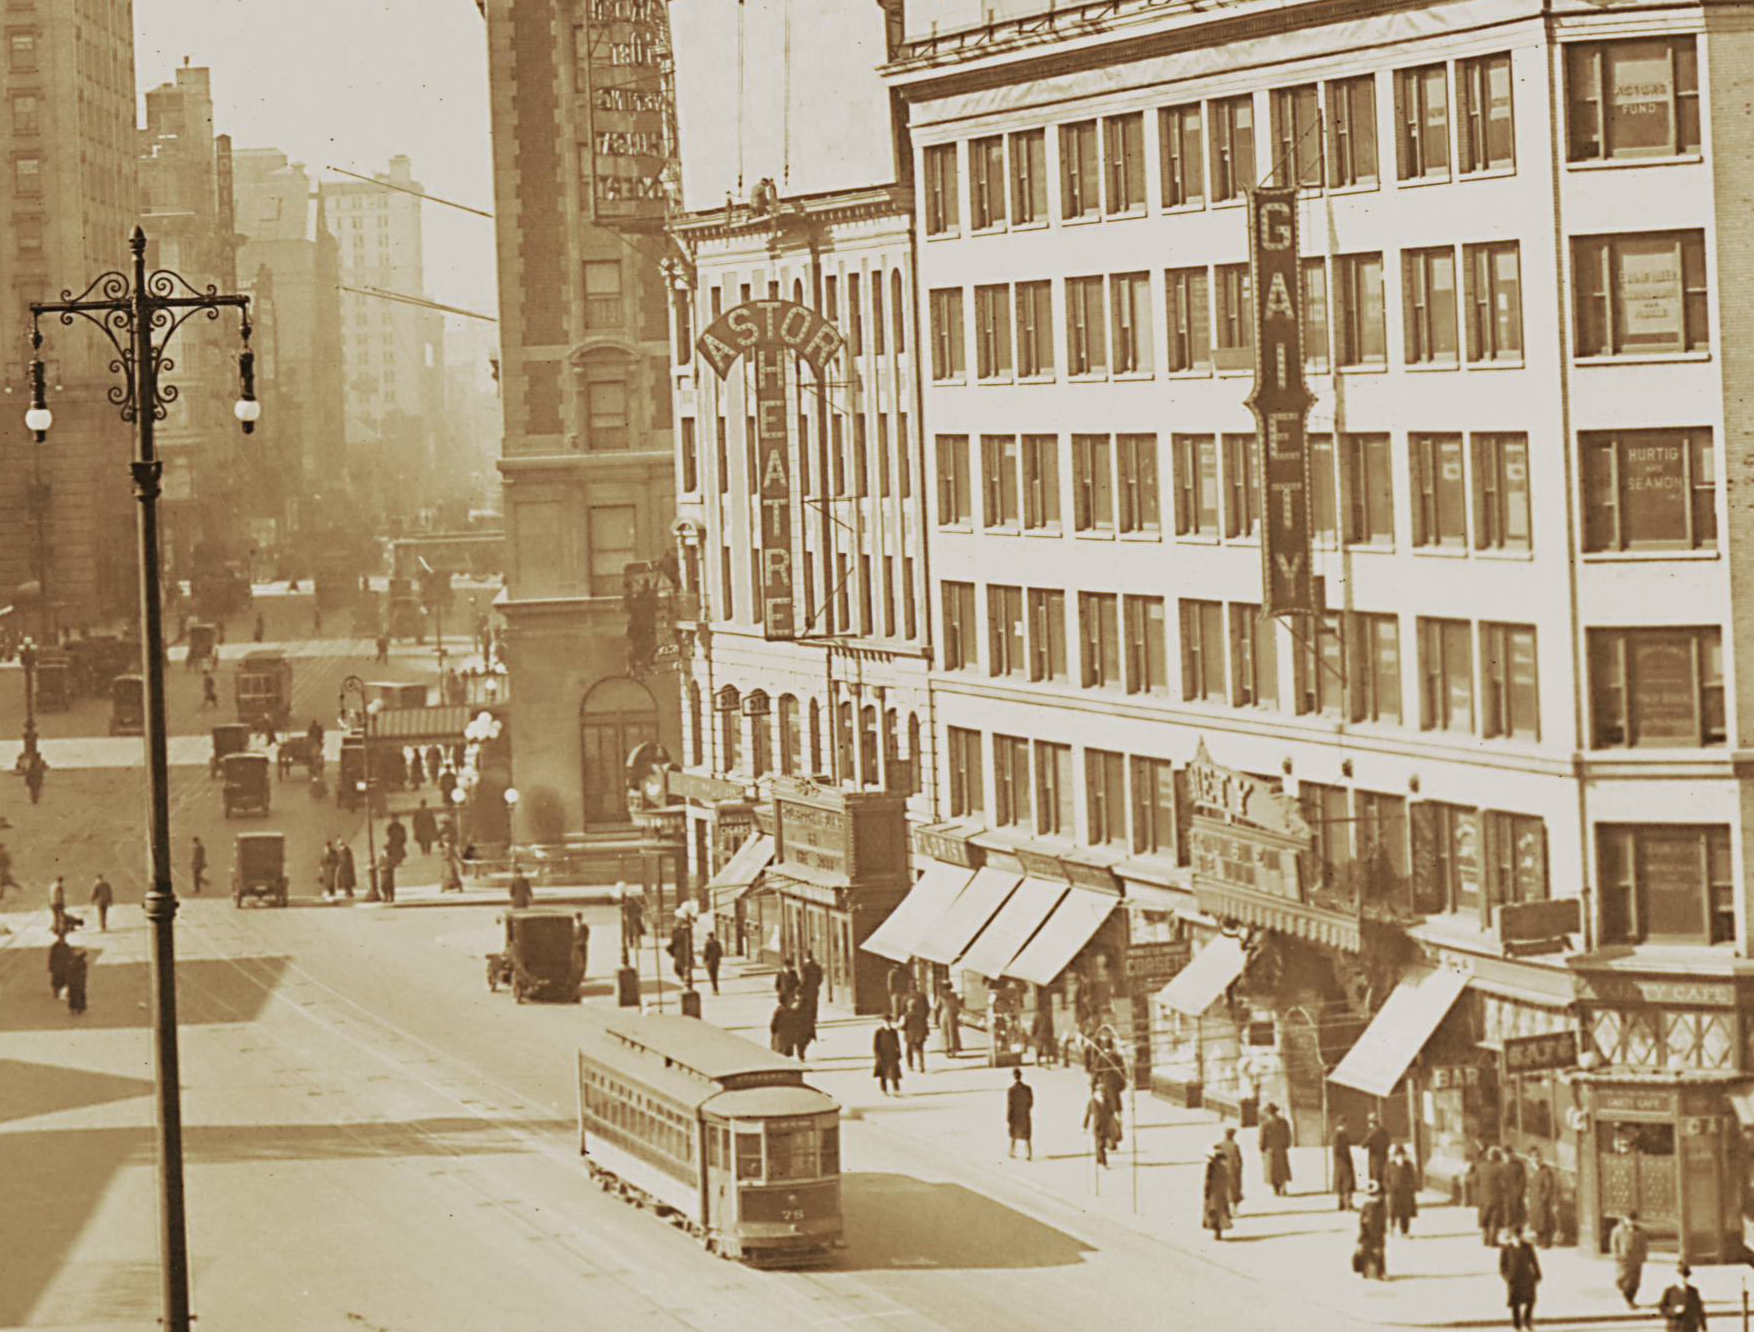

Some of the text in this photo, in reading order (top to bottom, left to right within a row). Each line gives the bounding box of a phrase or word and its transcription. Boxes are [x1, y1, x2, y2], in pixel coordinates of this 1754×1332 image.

[1622, 103, 1656, 114] FUND
[705, 301, 841, 370] ASTOR
[1258, 200, 1302, 599] GAIETY
[1628, 447, 1679, 463] HURTIG
[1627, 476, 1683, 492] SEAMON
[1672, 984, 1728, 1002] CAFE
